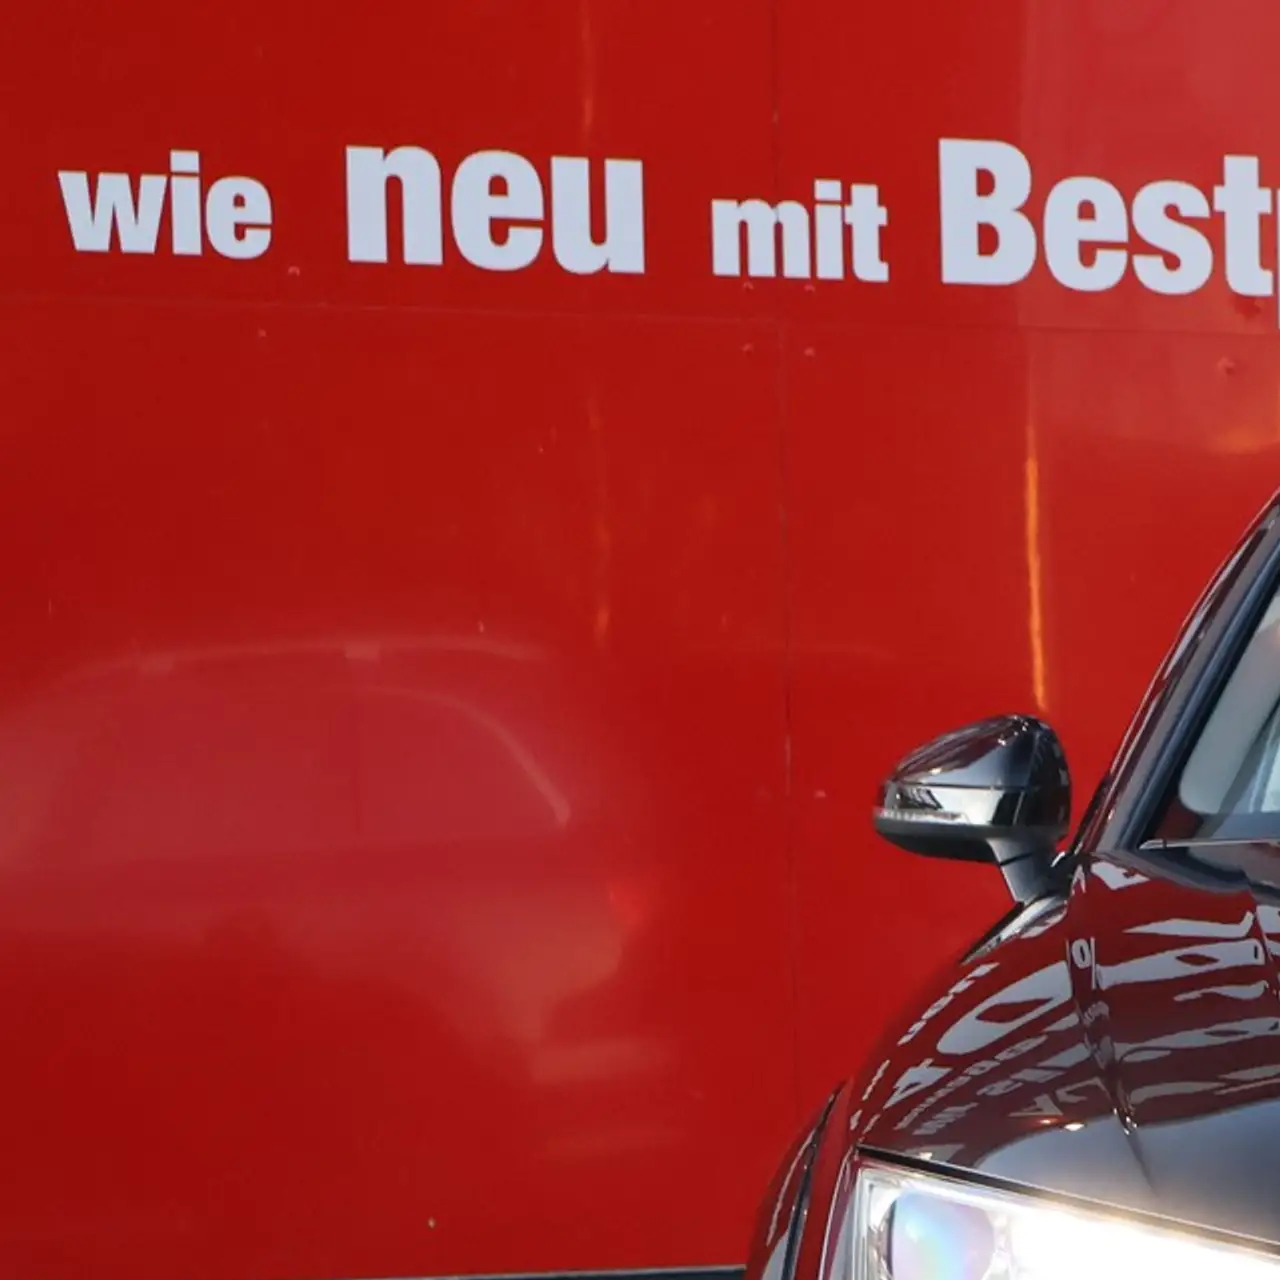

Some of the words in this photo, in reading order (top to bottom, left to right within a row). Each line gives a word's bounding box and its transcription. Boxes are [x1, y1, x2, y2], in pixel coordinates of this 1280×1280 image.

[58, 151, 272, 258] wie
[346, 145, 645, 274] neu
[711, 179, 889, 282] mit
